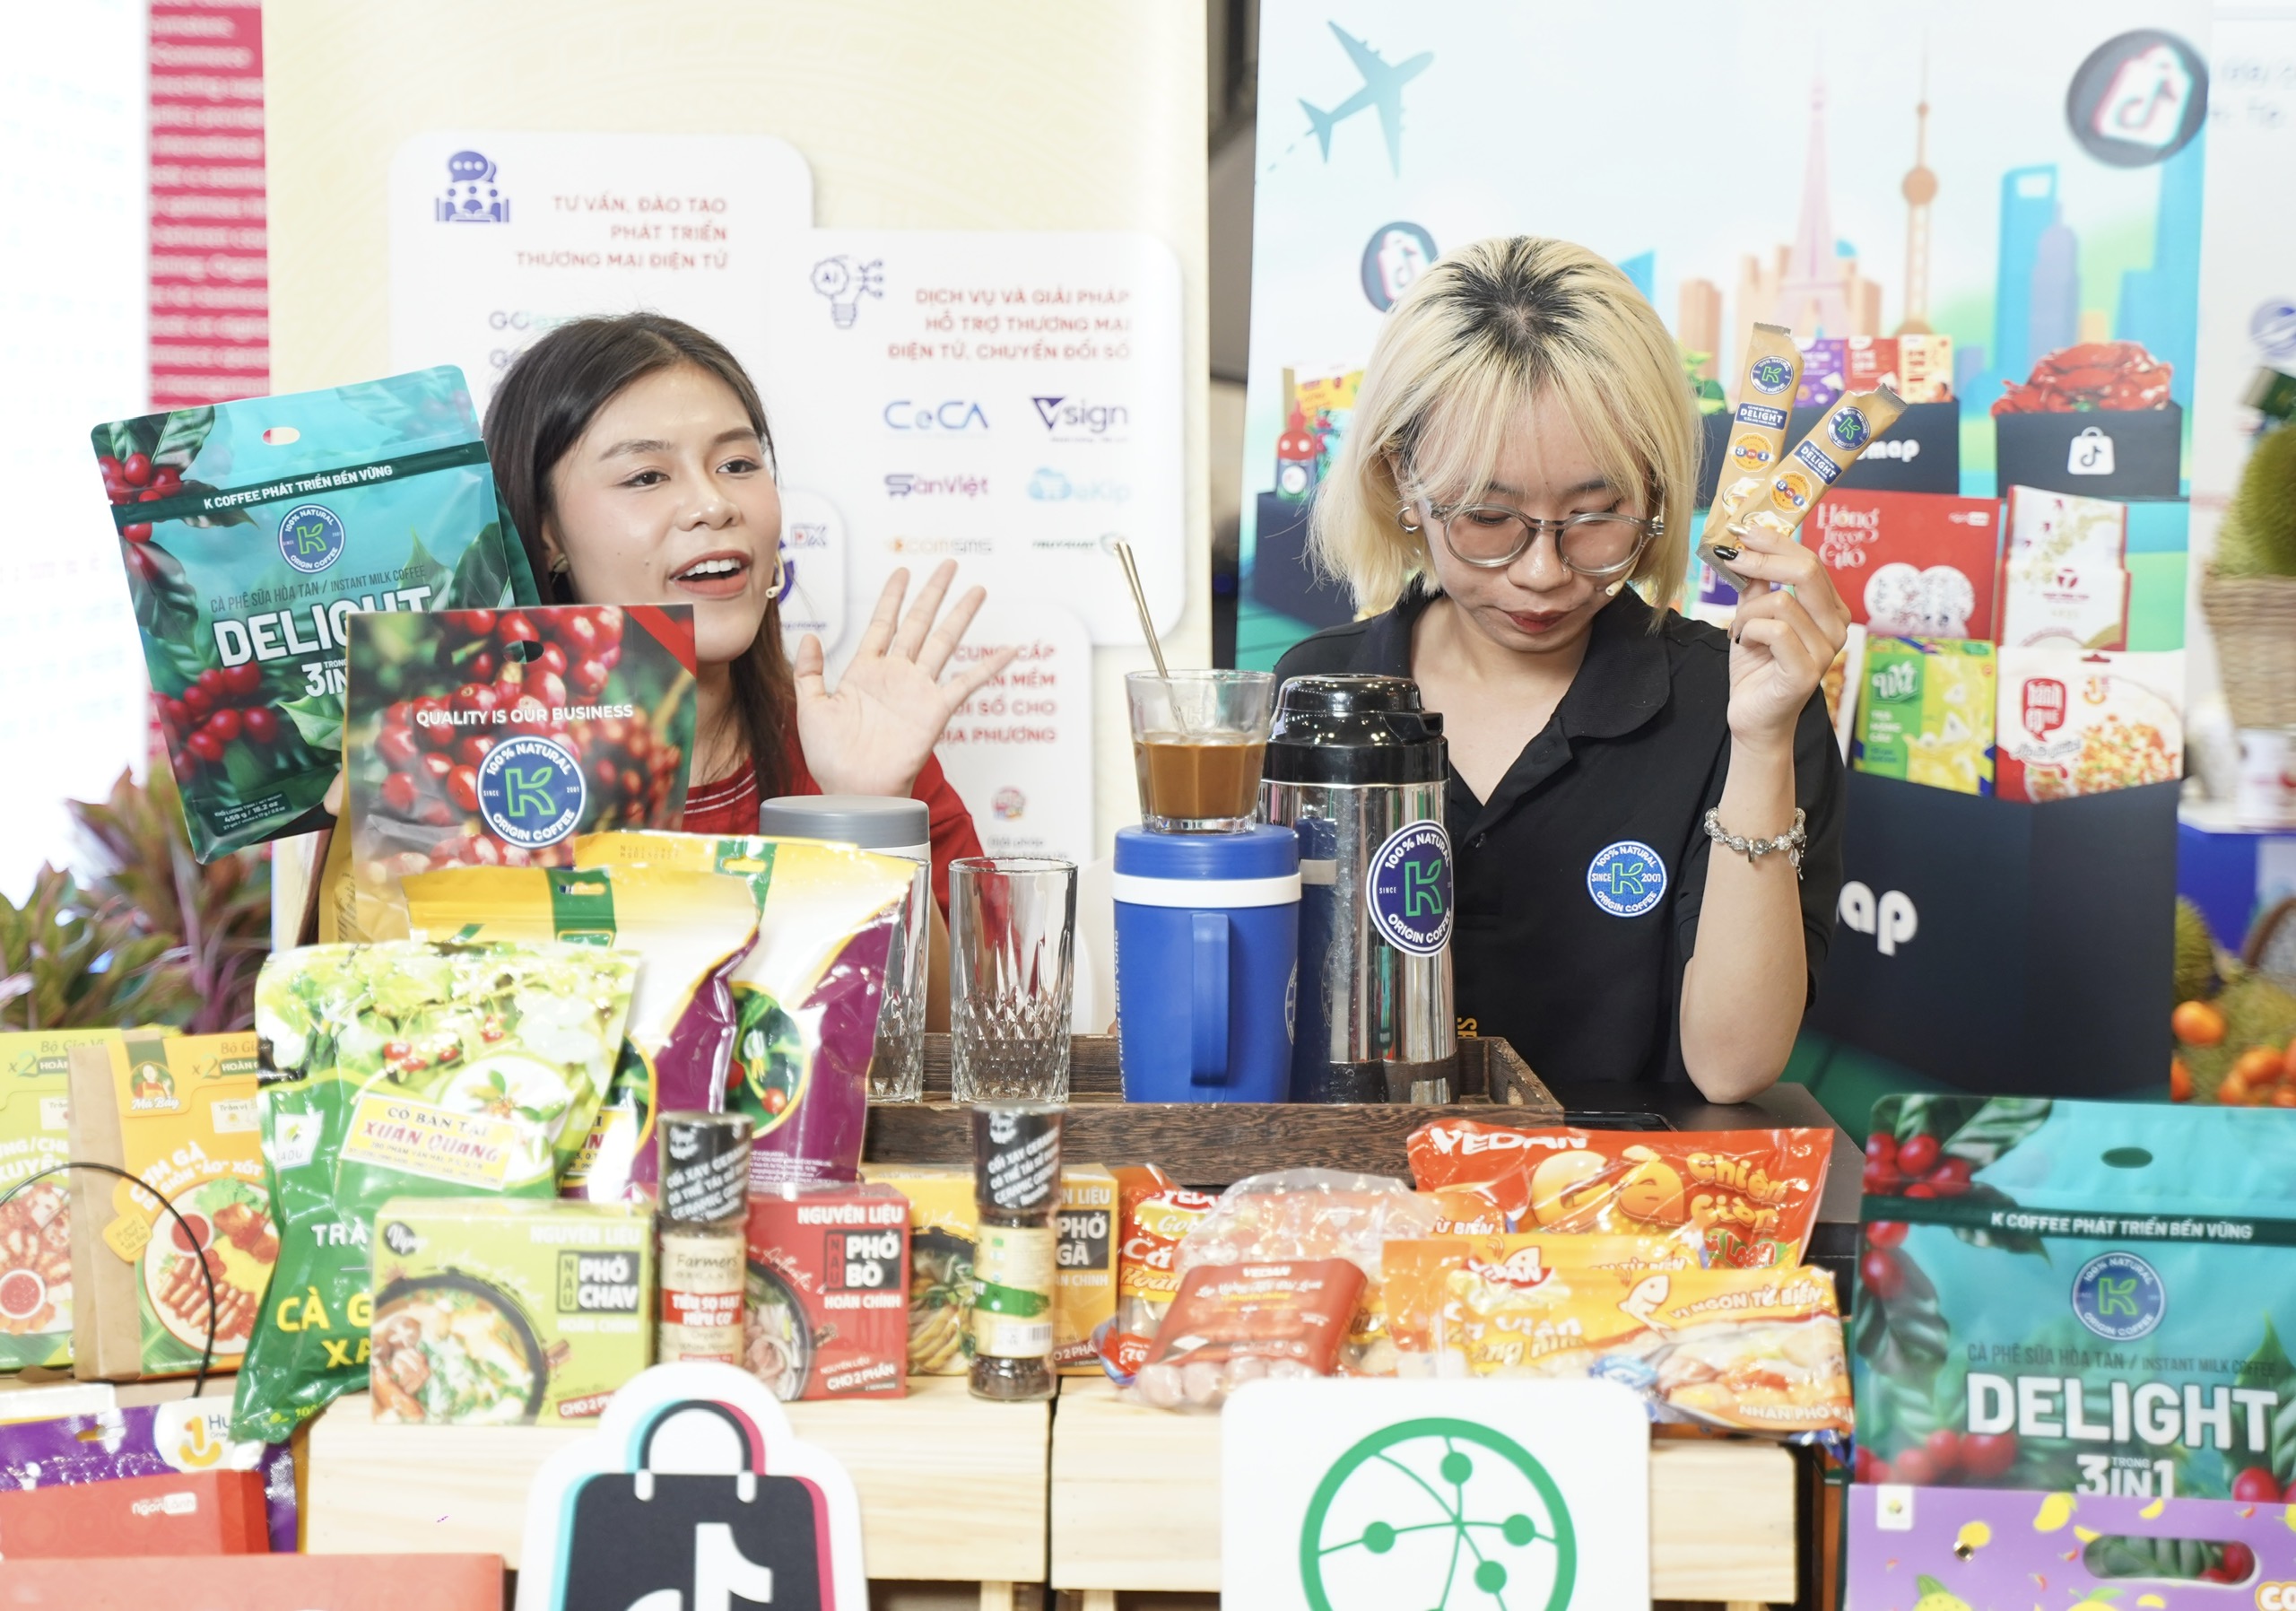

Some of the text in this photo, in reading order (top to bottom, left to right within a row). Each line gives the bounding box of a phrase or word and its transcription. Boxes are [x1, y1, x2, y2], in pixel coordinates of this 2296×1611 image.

[1740, 407, 1784, 423] DELIGHT
[1800, 446, 1837, 478] DELIGHT
[204, 464, 394, 509] K COFFEE PHÁT TRIỂN BỀN VỮNG
[285, 509, 335, 533] 100% NATURAL
[290, 546, 339, 569] ORIGIN COFFEE
[211, 564, 426, 614] CÀ PHÊ SỮA HÒA TAN INSTANT MILK COFFEE
[415, 703, 634, 728] QUALITY IS OUR BUSINESS
[1012, 699, 1057, 717] CHO
[485, 743, 572, 777] 100% NATURAL
[492, 806, 577, 842] ORIGIN COFFEE
[1384, 832, 1451, 870] 100% NATURAL
[1596, 845, 1658, 868] 100% NATURAL
[1378, 886, 1397, 895] SINCE
[1591, 873, 1662, 883] SINCE 2001
[1596, 890, 1658, 913] ORIGIN COFFEE
[1387, 906, 1452, 945] ORIGIN COFFEE
[1836, 880, 1918, 957] ap
[40, 1040, 58, 1053] Bộ
[221, 1041, 239, 1054] Bộ
[222, 1059, 252, 1072] HOÀN
[387, 1104, 411, 1121] CÓ
[415, 1110, 451, 1130] BÁN
[171, 1140, 207, 1167] GÀ
[426, 1132, 500, 1163] QUANG
[1429, 1127, 1587, 1155] VEDAN
[1005, 1148, 1026, 1166] XAY
[995, 1178, 1034, 1205] CERAMIC
[1685, 1151, 1792, 1206] Chiên
[1078, 1186, 1111, 1206] LIỆU
[797, 1204, 903, 1227] NGUYÊN LIỆU
[1057, 1211, 1107, 1239] PHỞ
[1690, 1193, 1780, 1232] Giòn
[310, 1216, 369, 1248] TRÀ
[529, 1223, 601, 1245] NGUYÊN
[1991, 1212, 2253, 1240] K COFFEE PHÁT TRIỂN BỀN VỮNG
[846, 1229, 900, 1259] PHỞ
[1056, 1241, 1090, 1266] GÀ
[578, 1255, 629, 1283] PHỞ
[676, 1253, 738, 1268] Farmers
[845, 1259, 883, 1287] BÒ
[2109, 1257, 2153, 1285] NATURAL
[275, 1285, 330, 1333] CÀ
[578, 1284, 639, 1309] CHAY
[824, 1293, 861, 1310] HOÀN
[1691, 1292, 1748, 1315] NGON
[2083, 1311, 2154, 1337] ORIGIN COFFEE
[1063, 1349, 1071, 1359] 2
[1967, 1343, 2277, 1378] CÀ PHÊ SỮA HÒA TAN INSTANT MILK COFFEE
[827, 1373, 853, 1390] CHO
[854, 1372, 862, 1384] 2
[559, 1398, 598, 1417] CHO 2
[1967, 1372, 2278, 1452] DELIGHT
[2112, 1456, 2152, 1469] TRONG
